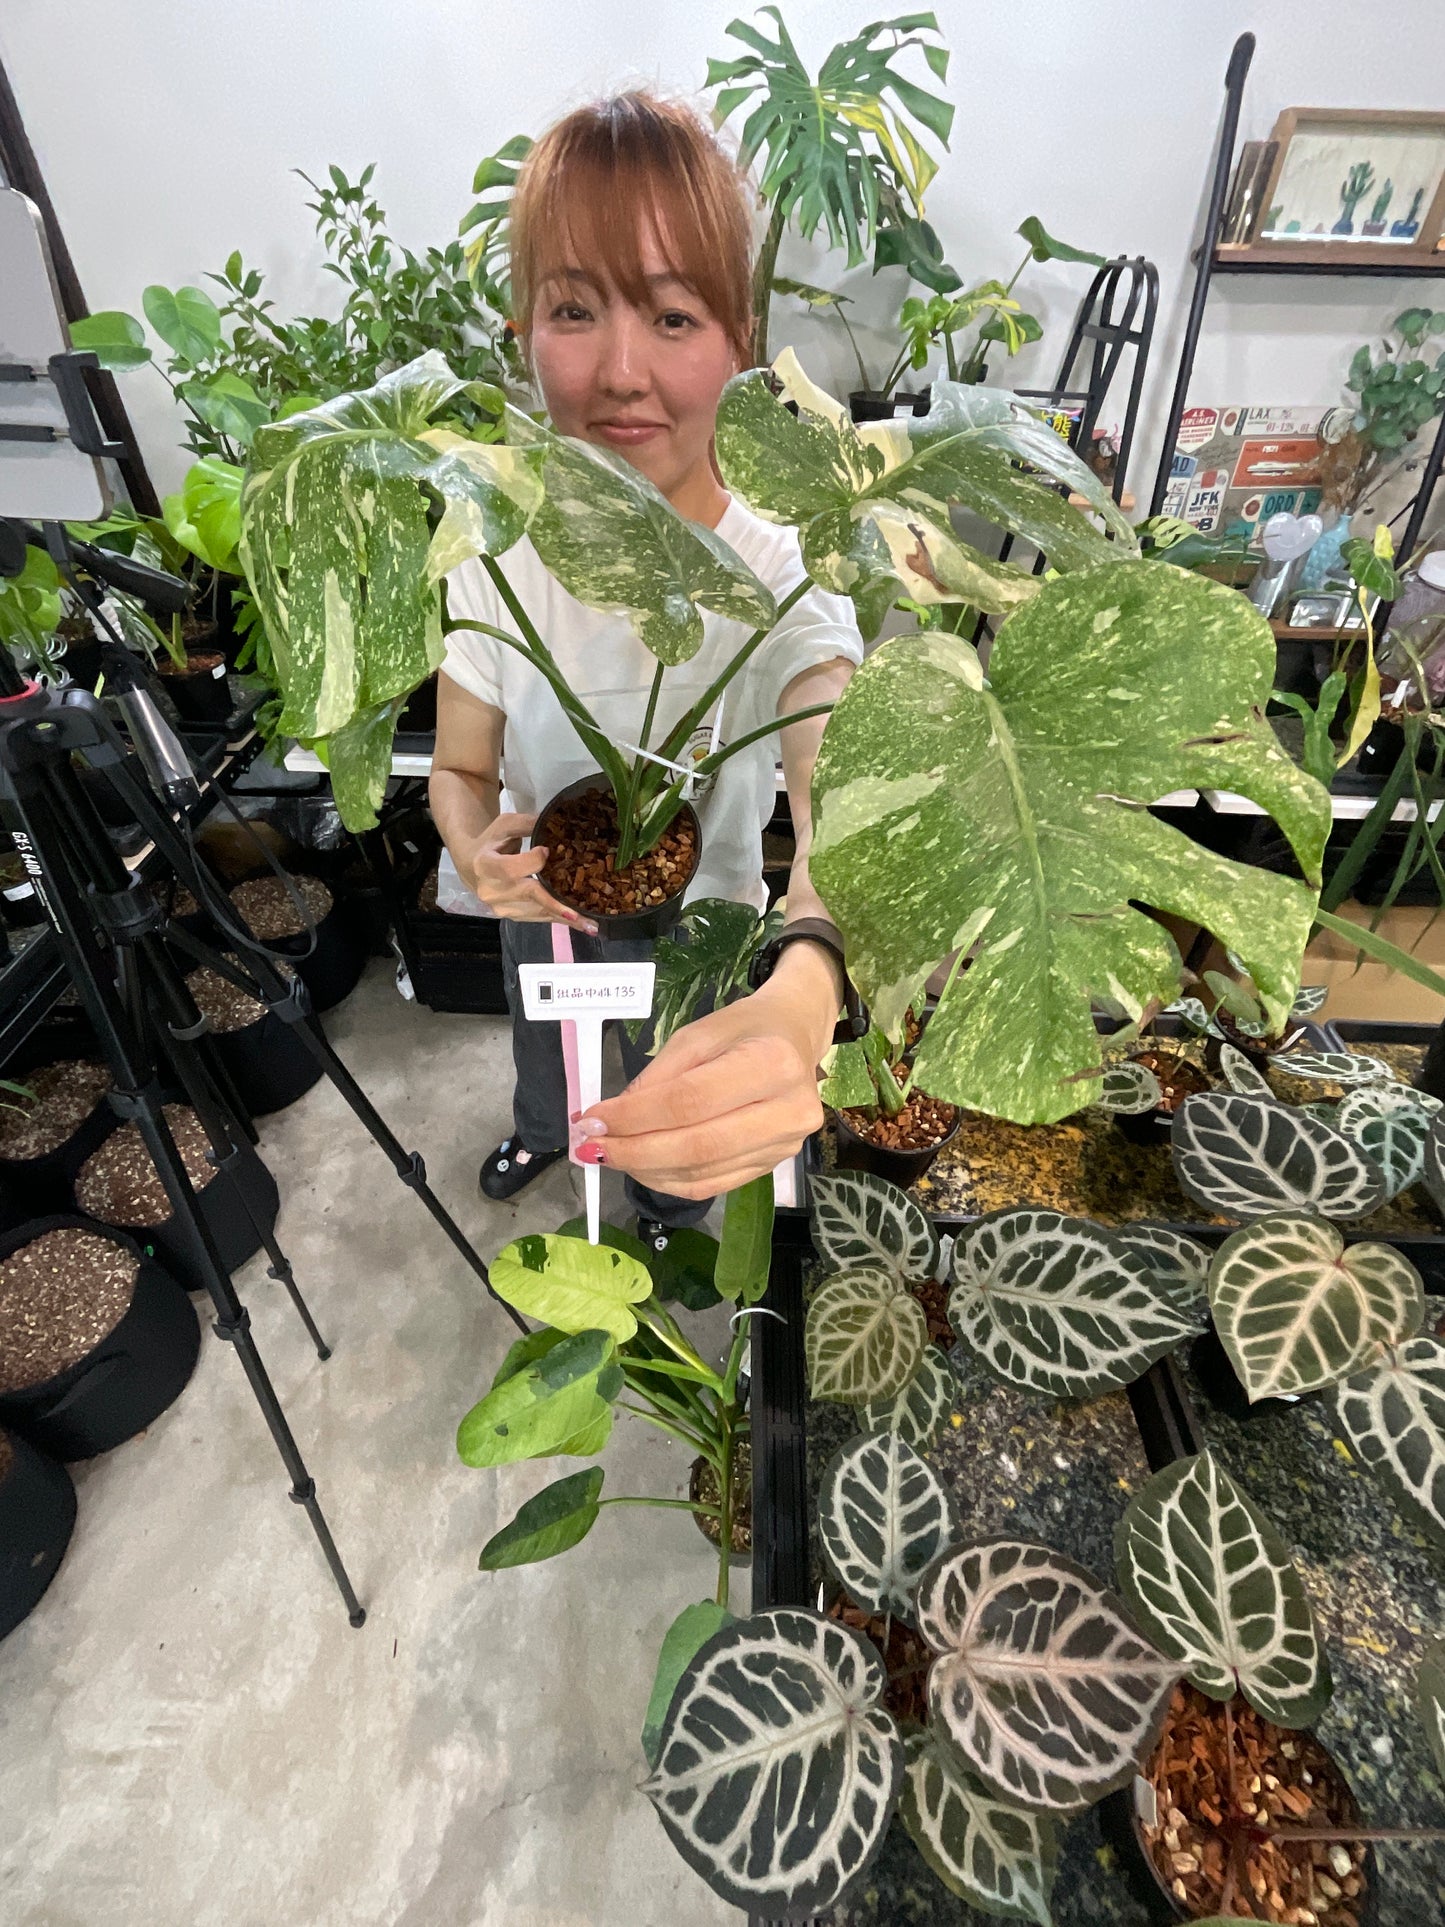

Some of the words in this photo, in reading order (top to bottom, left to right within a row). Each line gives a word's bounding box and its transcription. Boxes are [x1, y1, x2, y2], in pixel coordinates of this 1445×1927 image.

[1249, 408, 1271, 420] LAX
[1191, 490, 1220, 506] JFK
[1265, 495, 1294, 513] ORD
